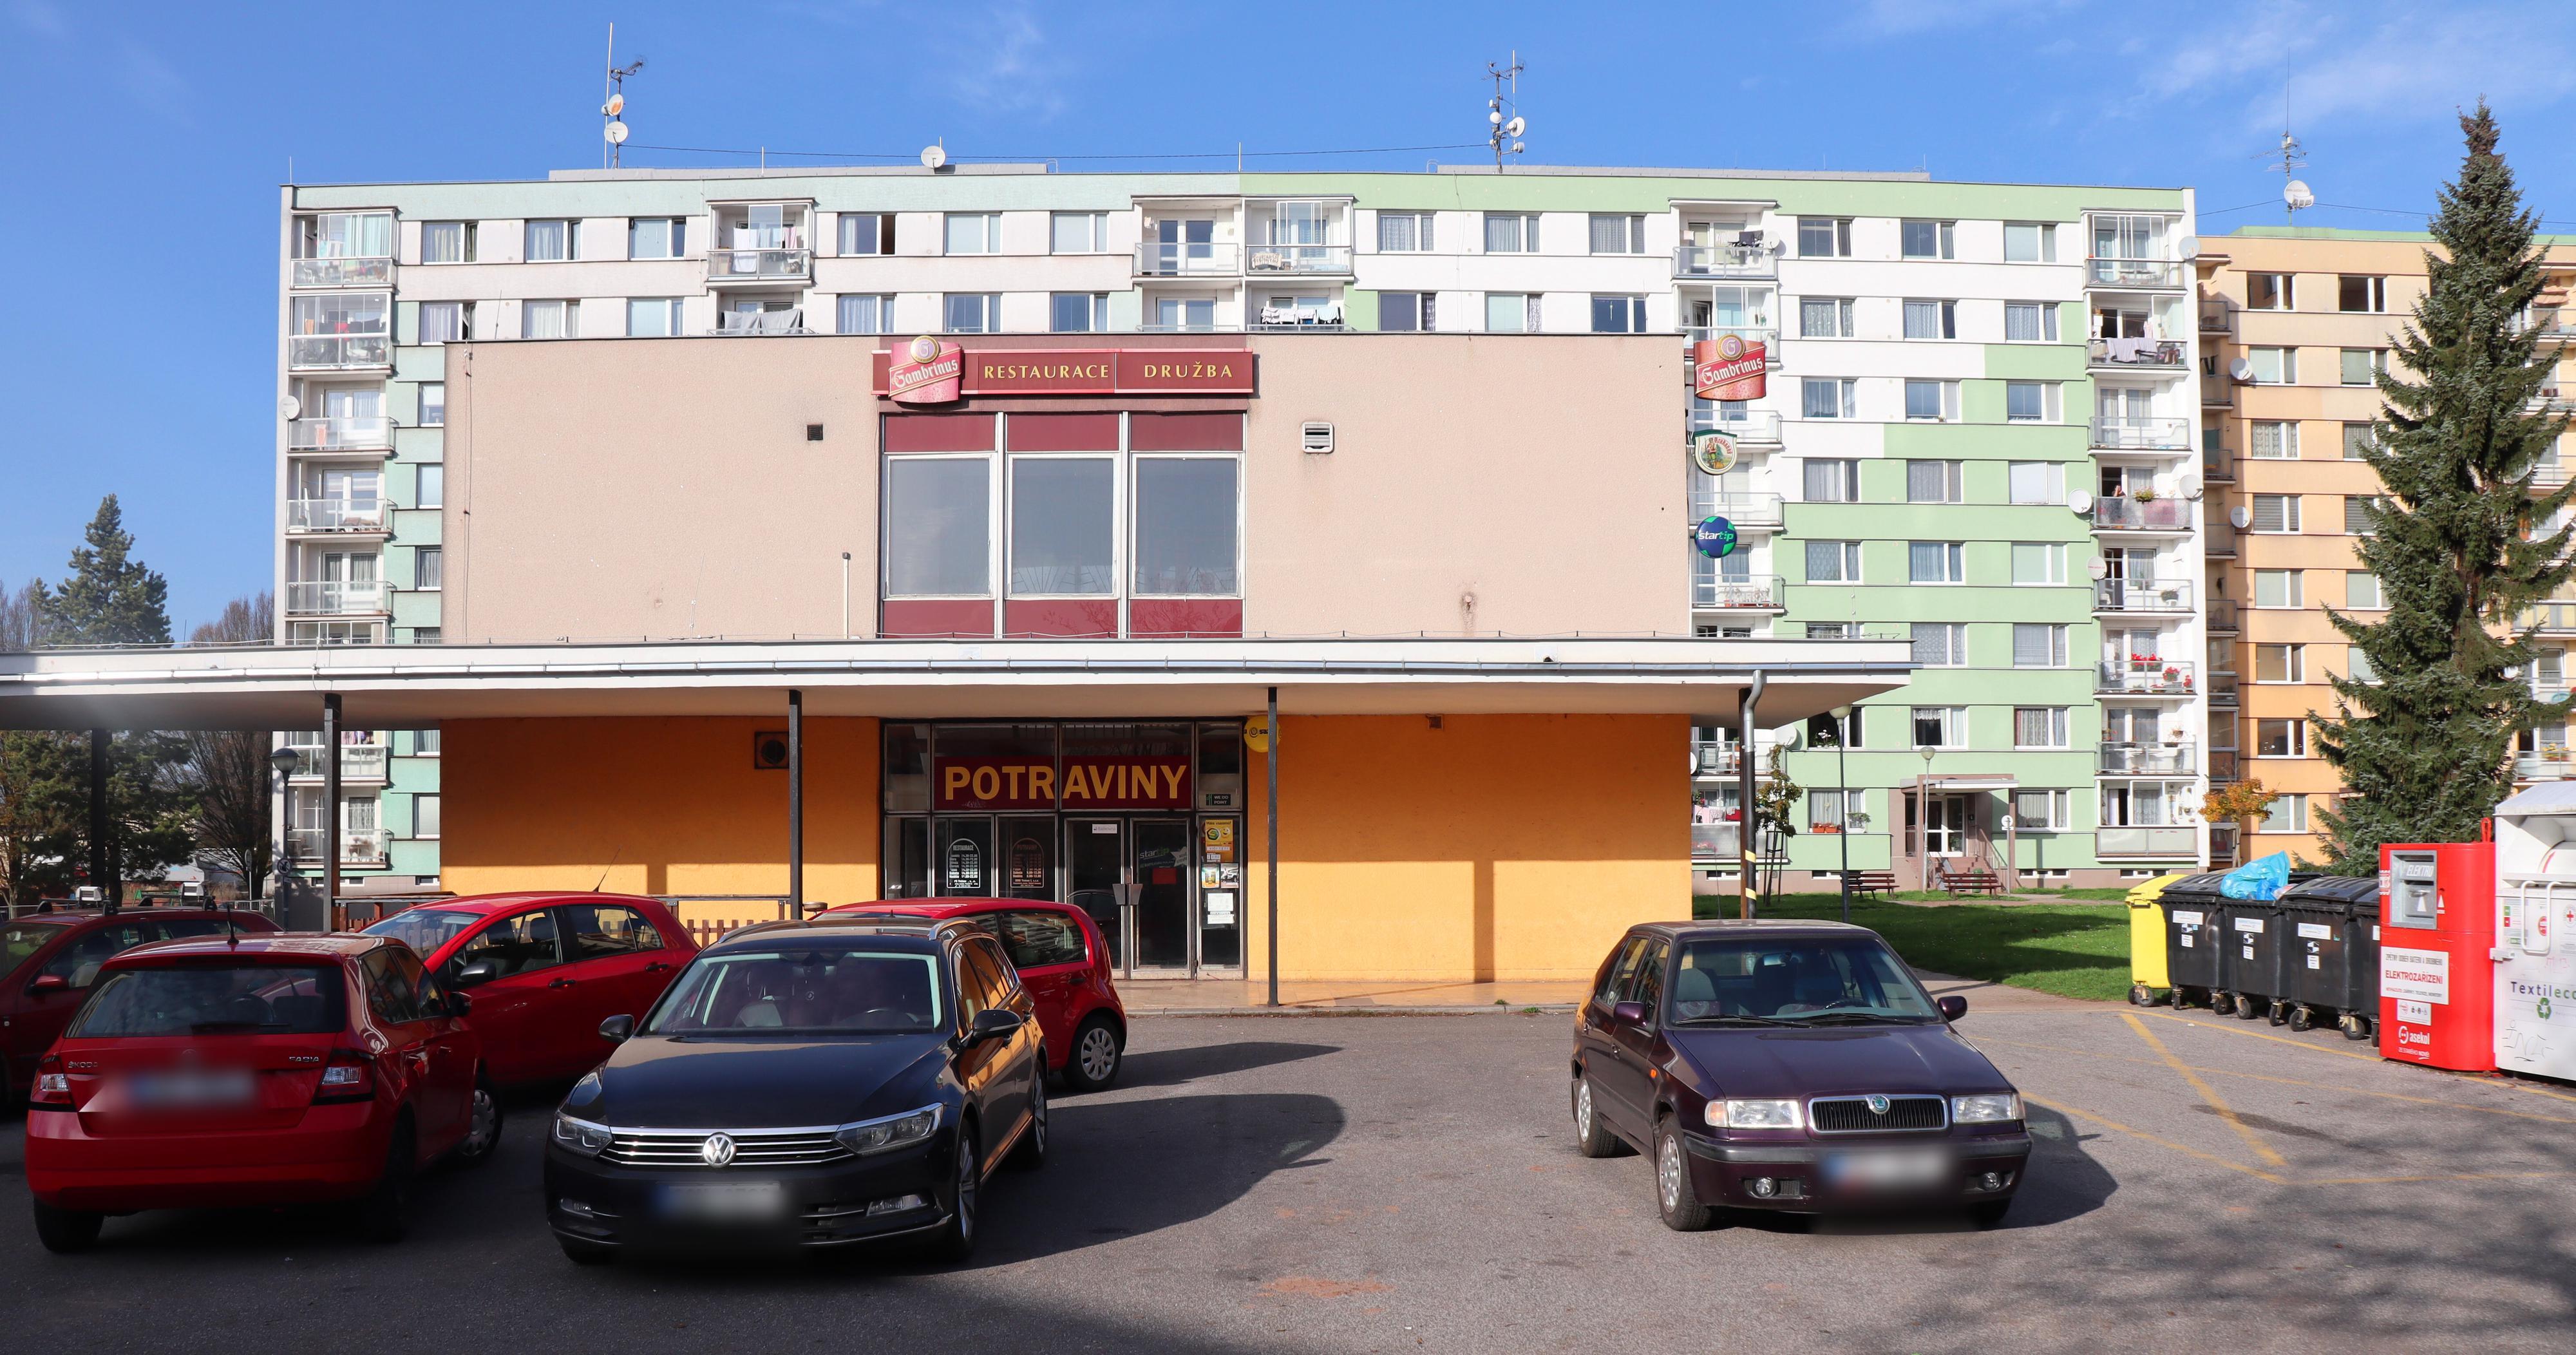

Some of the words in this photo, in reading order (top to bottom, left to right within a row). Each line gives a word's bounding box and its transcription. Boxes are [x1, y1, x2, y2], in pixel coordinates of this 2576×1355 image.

[891, 359, 958, 388] Gambrinus
[983, 364, 1110, 379] RESTAURACE
[1144, 360, 1234, 379] DRUŽBA
[1700, 357, 1763, 385] Gambrinus
[1698, 530, 1734, 542] startip
[945, 764, 1188, 801] POTRAVINY
[2406, 864, 2434, 877] ELEKTRO
[2409, 1031, 2430, 1045] asekol
